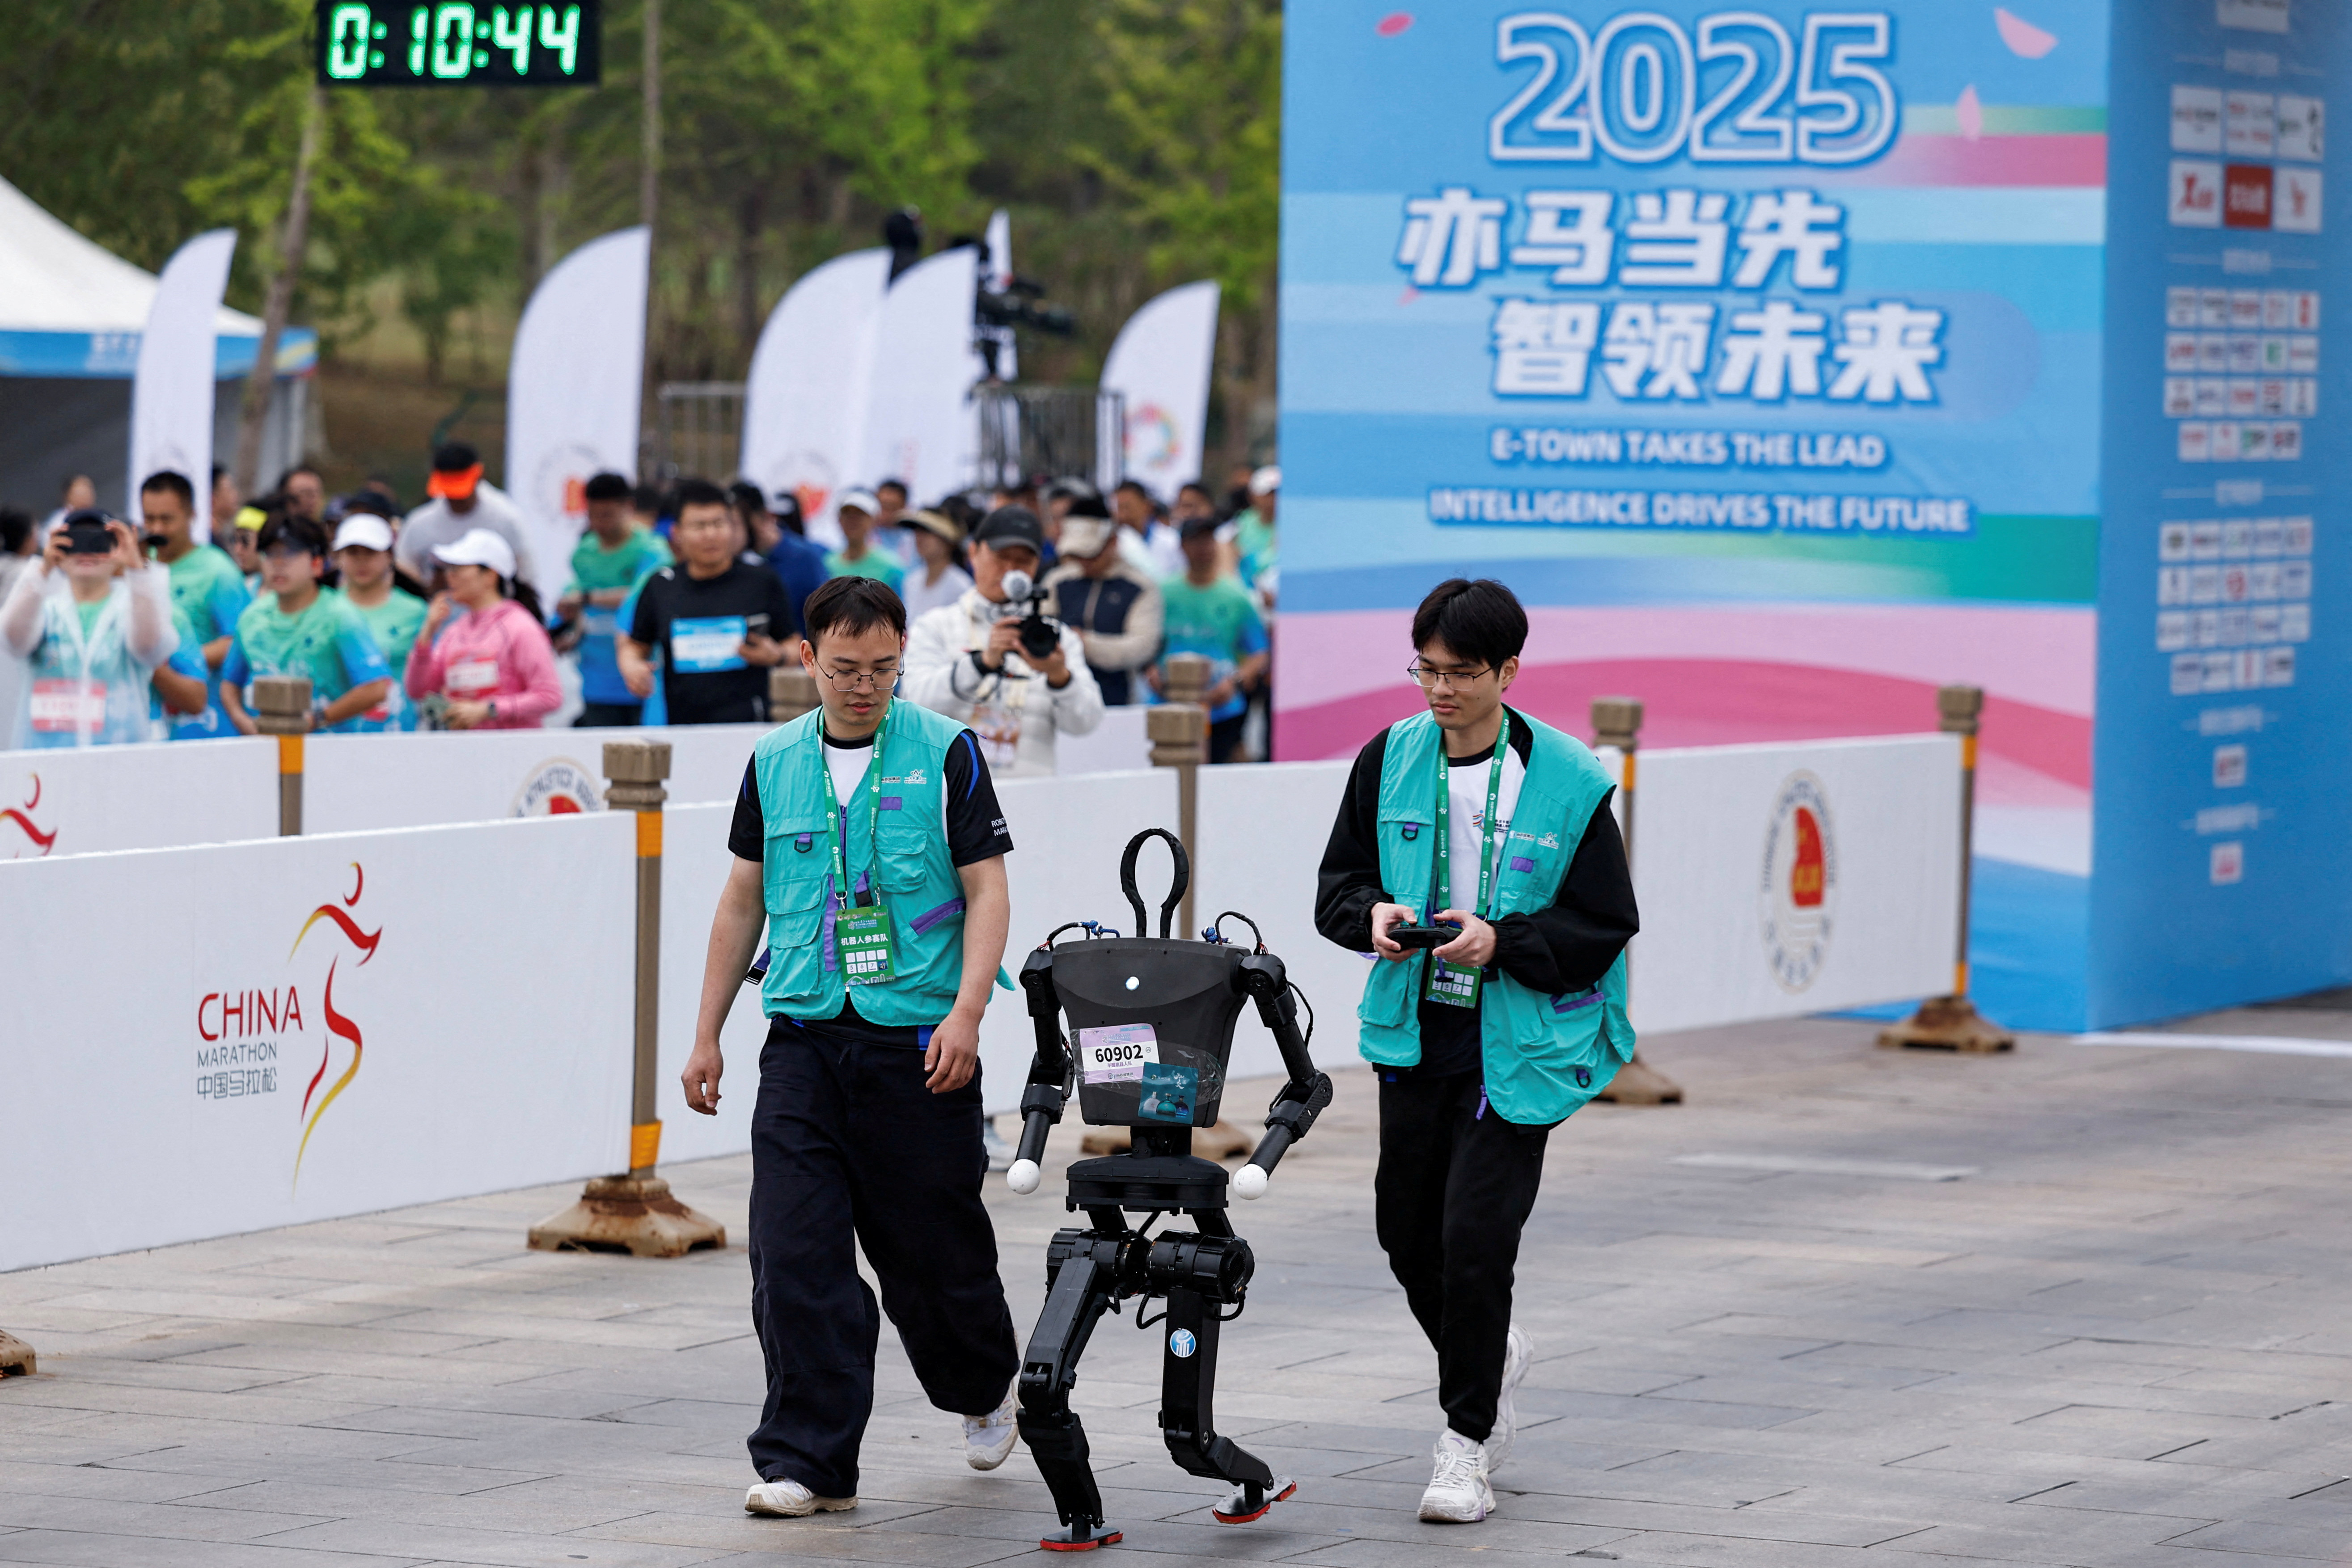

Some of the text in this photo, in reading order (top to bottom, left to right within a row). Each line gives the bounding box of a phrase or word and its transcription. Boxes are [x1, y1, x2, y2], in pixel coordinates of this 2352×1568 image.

[1488, 12, 1897, 164] 2025
[1396, 188, 1844, 289] 亦马当先
[1490, 298, 1943, 402] 智领未来
[1490, 428, 1886, 468] E-TOWN TAKES THE LEAD
[1430, 488, 1970, 532] INTELLIGENCE DRIVES THE FUTURE
[841, 933, 888, 946] 机器人参赛队
[198, 985, 303, 1042] CHINA
[198, 1042, 277, 1068] MARATHON
[1095, 1044, 1143, 1063] 60902
[197, 1067, 277, 1100] 中国马拉松
